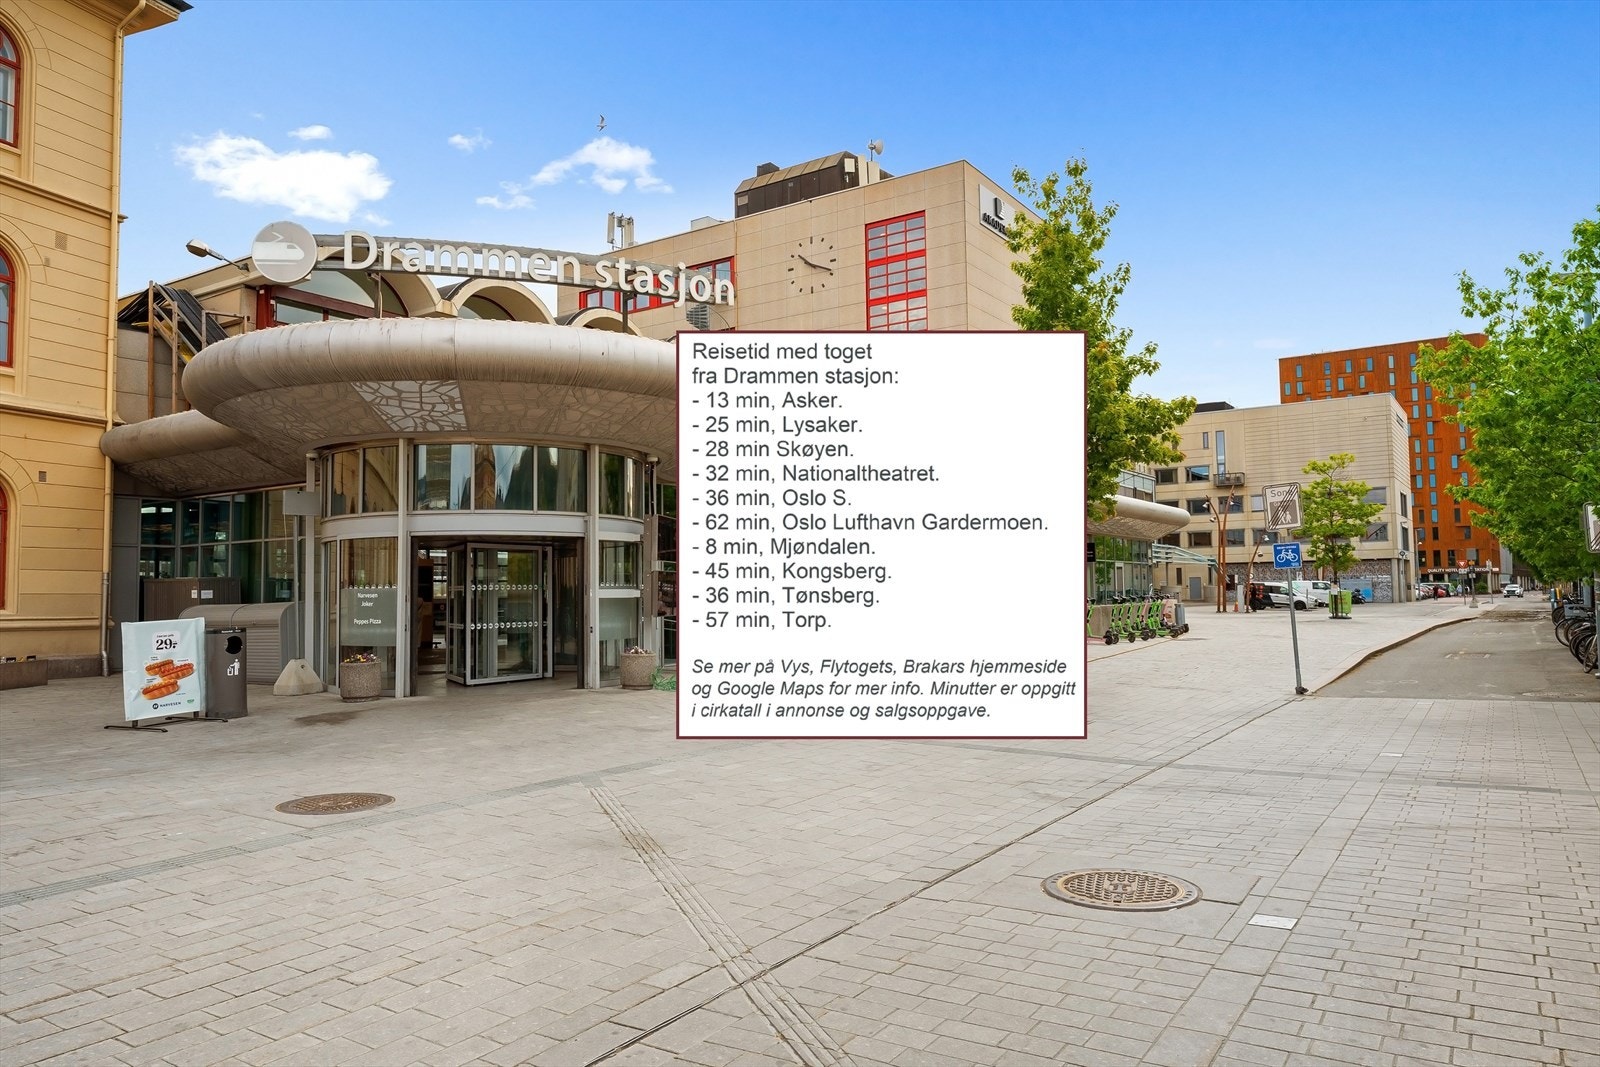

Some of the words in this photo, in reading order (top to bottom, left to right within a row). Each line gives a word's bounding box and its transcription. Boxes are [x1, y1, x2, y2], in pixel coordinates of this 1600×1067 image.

[343, 229, 587, 284] Drammen
[595, 256, 735, 309] stasjon
[353, 618, 369, 626] Peppes
